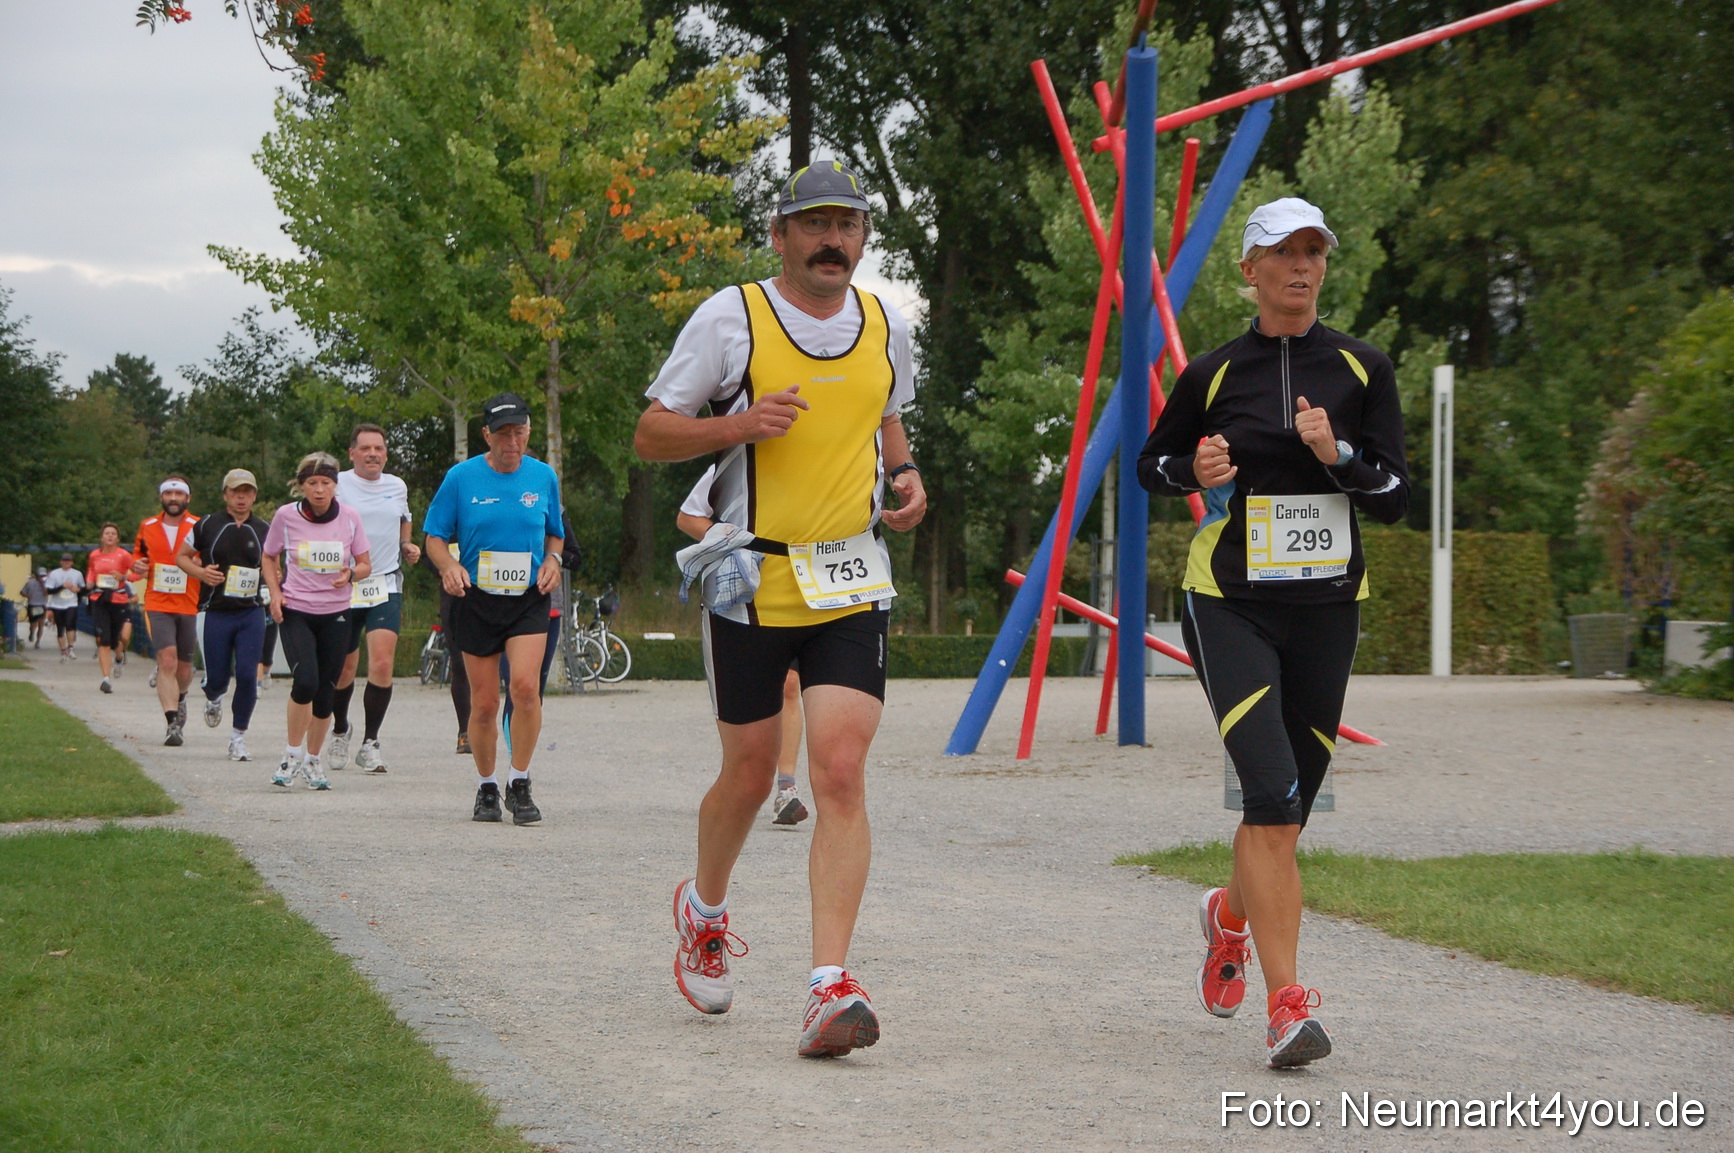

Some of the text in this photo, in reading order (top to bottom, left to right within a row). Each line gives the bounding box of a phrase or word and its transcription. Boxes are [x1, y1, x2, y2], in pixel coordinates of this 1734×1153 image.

[1276, 503, 1319, 519] Carola
[1251, 529, 1258, 541] D
[1286, 528, 1333, 552] 299
[816, 540, 846, 555] Heinz
[312, 552, 340, 562] 1008
[494, 569, 526, 581] 1002
[796, 565, 803, 576] C
[825, 558, 868, 583] 753
[164, 576, 181, 585] 495
[240, 579, 256, 588] 875
[362, 586, 380, 597] 601
[859, 586, 892, 598] PFLEIDERER
